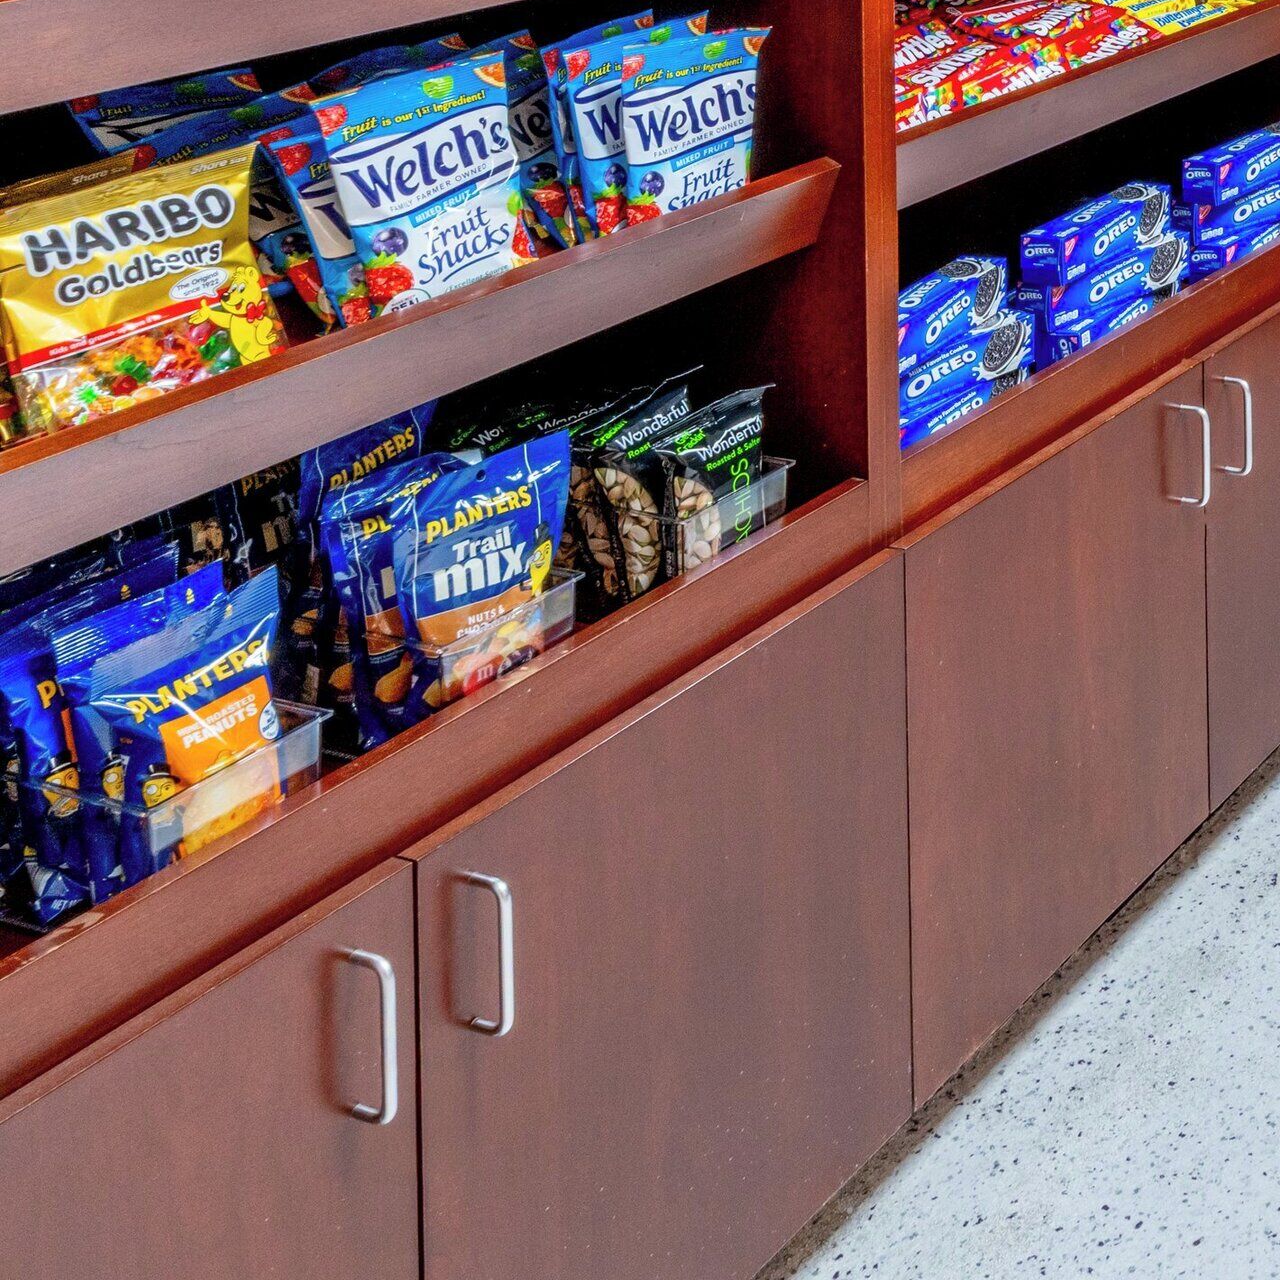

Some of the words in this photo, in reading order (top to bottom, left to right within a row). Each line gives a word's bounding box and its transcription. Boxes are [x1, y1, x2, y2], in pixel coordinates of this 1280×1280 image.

[584, 64, 611, 84] Fruit
[634, 70, 663, 90] Fruit
[666, 71, 673, 79] is
[675, 68, 689, 77] our
[342, 117, 379, 141] Fruit
[381, 116, 391, 126] is
[395, 112, 413, 123] our
[654, 146, 679, 157] FAMILY
[682, 131, 713, 148] FARMER
[716, 119, 744, 134] OWNED
[191, 160, 228, 174] Share
[341, 117, 510, 208] Welch's
[676, 151, 701, 168] MIXED
[703, 141, 729, 156] FRUIT
[390, 199, 413, 212] FAMILY
[417, 180, 452, 201] FARMER
[455, 163, 487, 182] OWNED
[682, 158, 734, 197] Fruit
[24, 187, 231, 273] HARIBO
[426, 206, 491, 254] Fruit
[1094, 215, 1136, 256] OREO
[418, 223, 510, 284] Snacks
[1025, 248, 1055, 256] OREO
[1192, 253, 1217, 261] OREO
[59, 242, 221, 303] Goldbears
[1089, 262, 1144, 302] OREO
[1018, 292, 1042, 300] OREO
[1018, 292, 1042, 300] OREO
[926, 296, 970, 345] OREO
[906, 350, 977, 398] OREO
[926, 350, 949, 367] Favorite
[950, 344, 968, 353] Cookie
[615, 399, 691, 450] Wonderful
[707, 451, 736, 471] Roasted
[452, 526, 511, 563] Trail
[433, 541, 527, 602] mix
